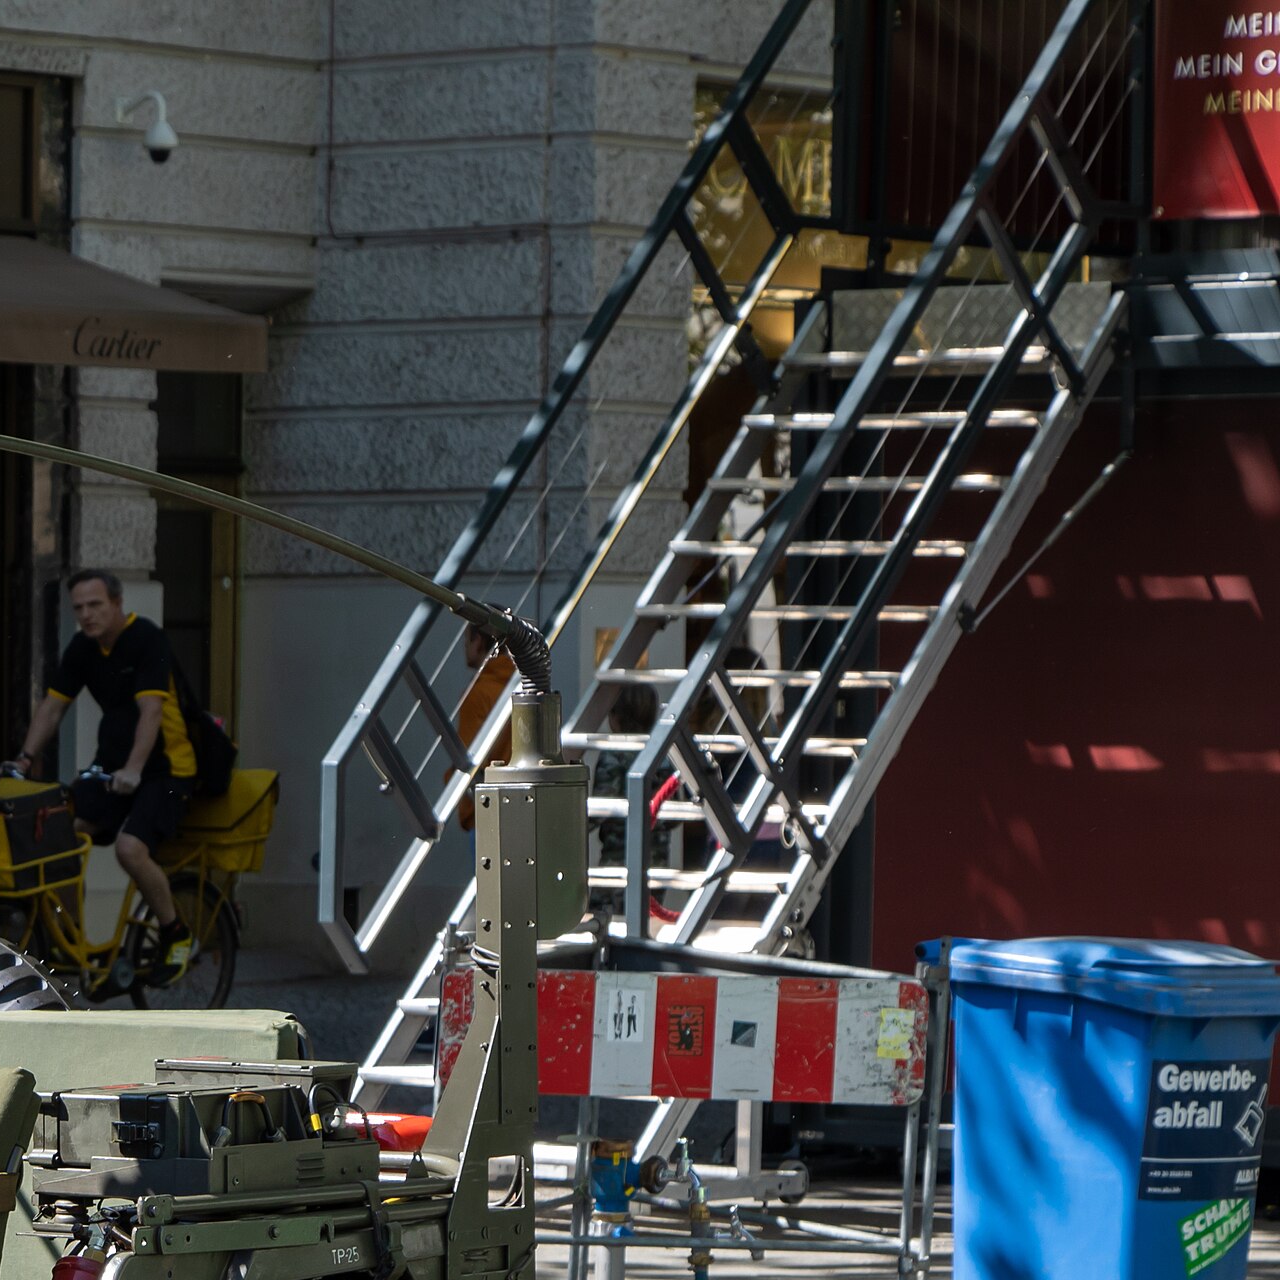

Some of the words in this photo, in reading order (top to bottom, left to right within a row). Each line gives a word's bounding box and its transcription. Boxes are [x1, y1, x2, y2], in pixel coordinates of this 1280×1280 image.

[1173, 51, 1244, 80] MEIN
[1254, 49, 1280, 76] G
[1203, 87, 1280, 116] MEIN
[72, 316, 162, 359] Cartier
[1158, 1063, 1257, 1092] Gewerbe-
[1153, 1100, 1223, 1129] abfall
[1185, 1200, 1250, 1261] TRUHE
[331, 1246, 360, 1265] TP-25
